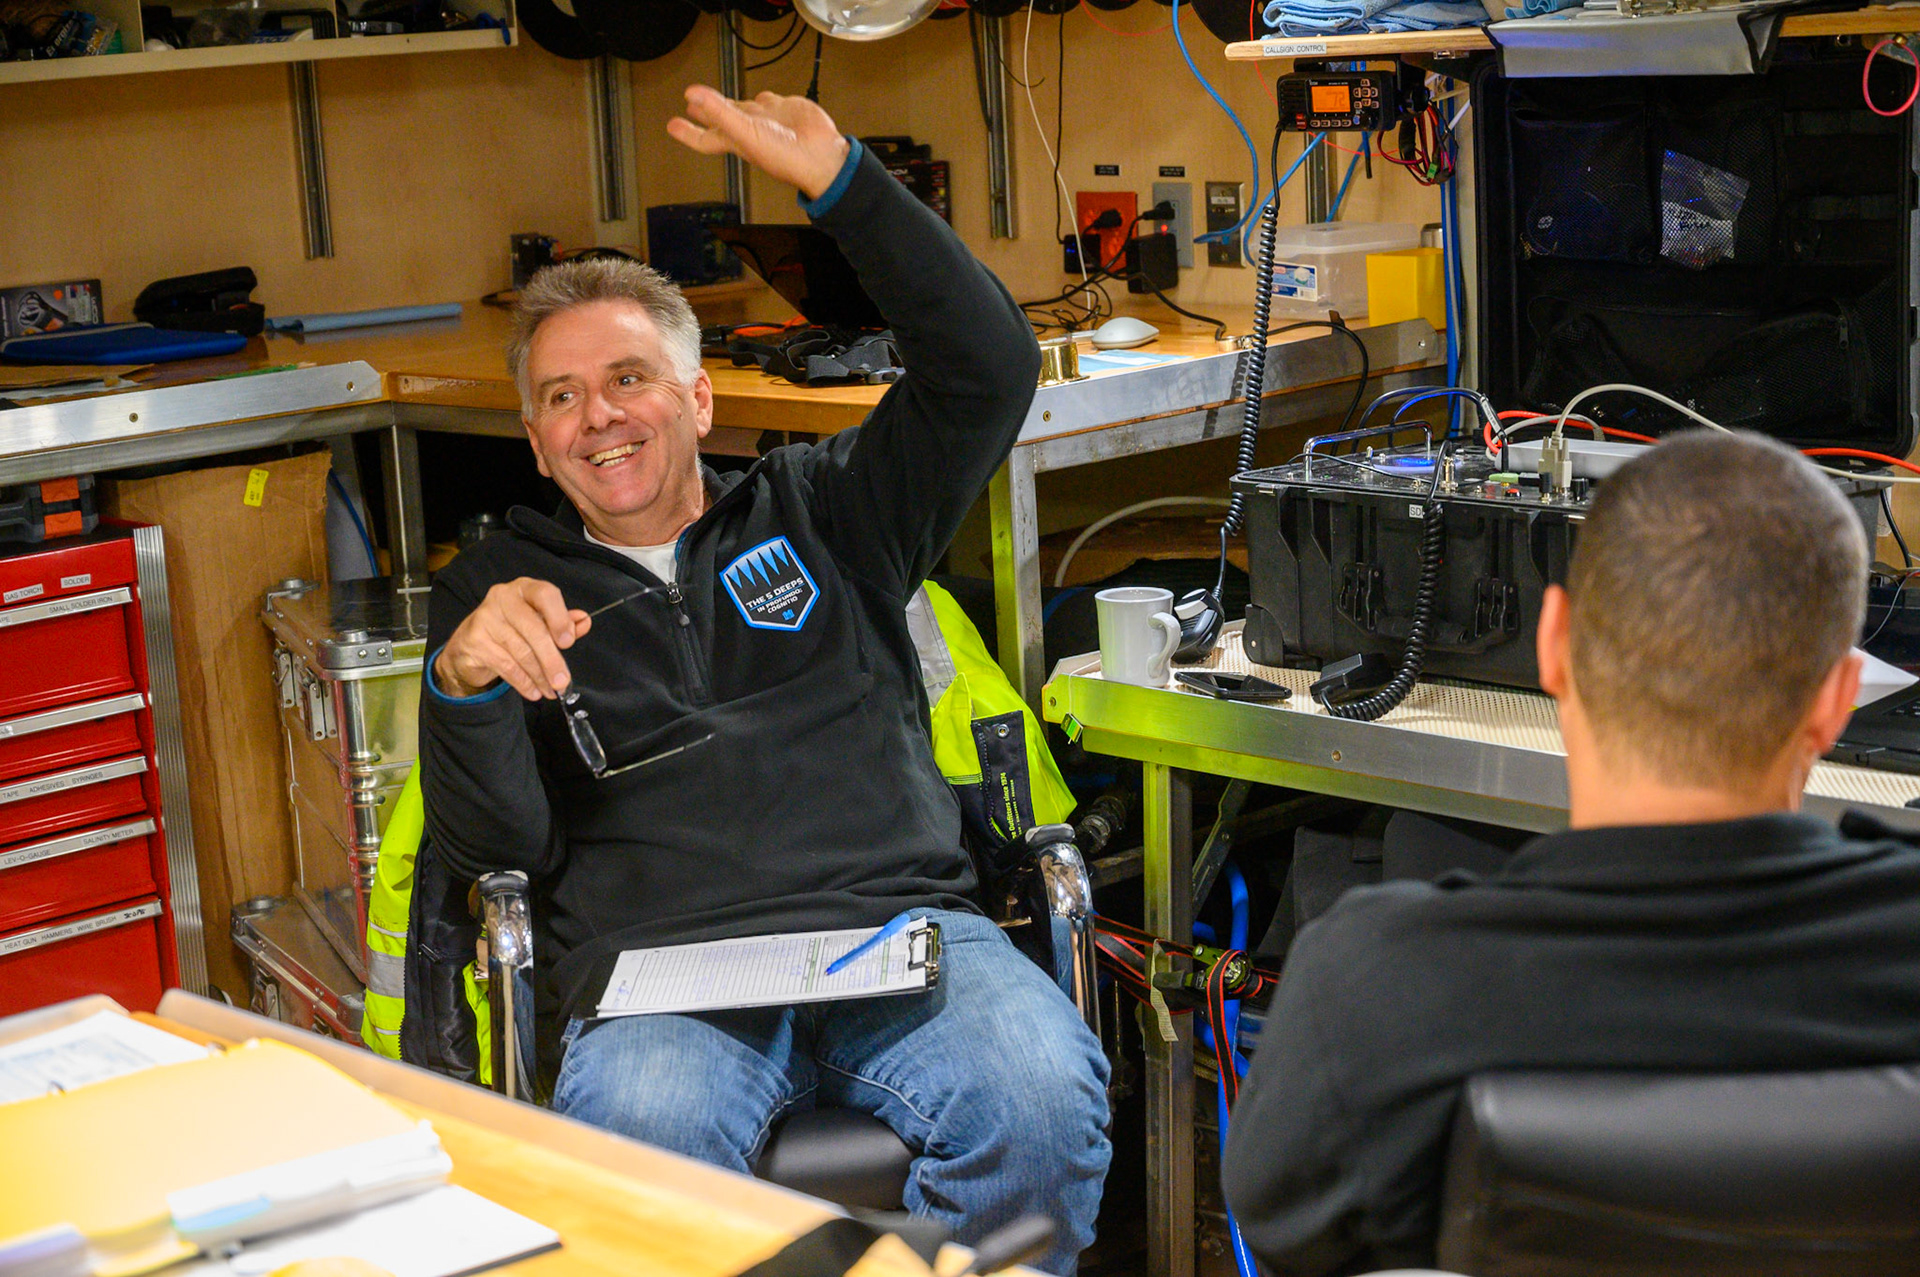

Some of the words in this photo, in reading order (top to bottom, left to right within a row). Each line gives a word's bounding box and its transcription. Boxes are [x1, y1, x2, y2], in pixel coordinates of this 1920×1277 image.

[1297, 44, 1325, 53] CONTROL
[63, 576, 90, 585] SOLDER
[4, 592, 18, 600] GAS
[20, 587, 42, 598] TORCH
[746, 595, 766, 608] THE
[765, 592, 773, 600] 5
[773, 577, 804, 596] DEEPS
[49, 605, 70, 613] SMALL
[71, 599, 96, 608] SOLDER
[97, 595, 113, 604] IRON
[757, 605, 766, 613] IN
[3, 790, 19, 799] TAPE
[29, 781, 65, 793] ADHESIVES
[71, 771, 104, 784] SYRINGES
[4, 849, 51, 865] LEV-O-GAUGE
[83, 833, 111, 845] SALINITY
[111, 828, 134, 839] METER
[4, 941, 21, 950] HEAT
[22, 937, 37, 946] GUN
[41, 928, 73, 940] HAMMERS
[77, 922, 94, 932] WIRE
[95, 916, 117, 928] BRUSH
